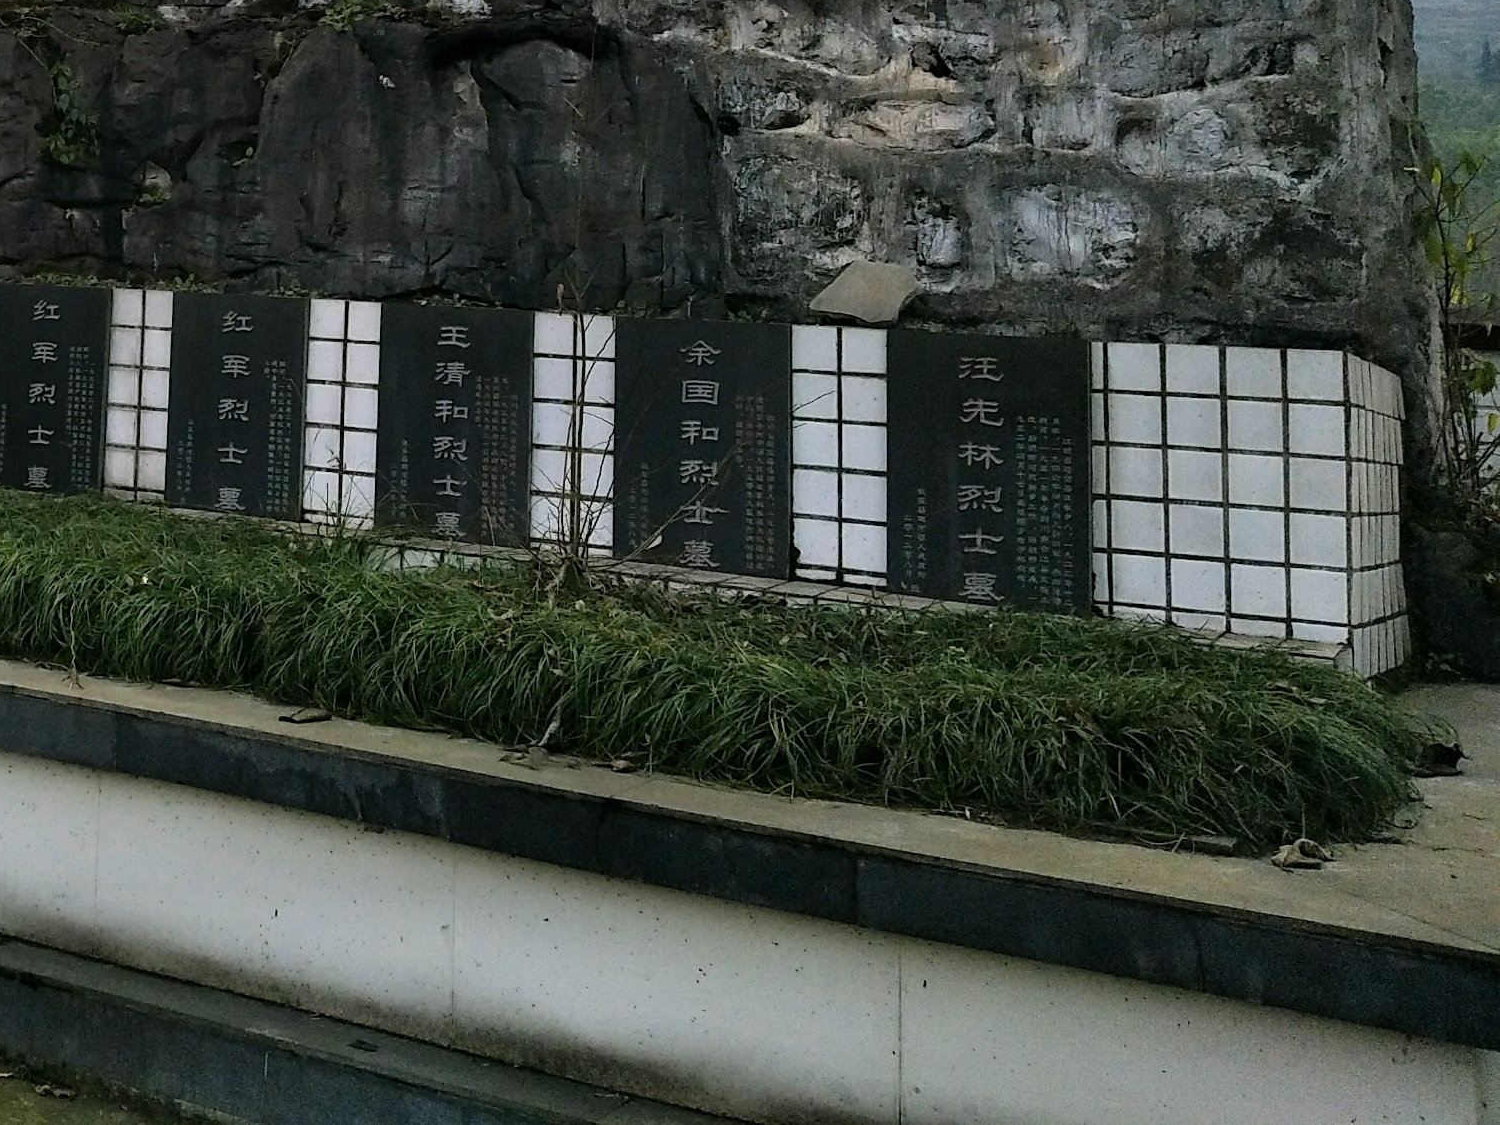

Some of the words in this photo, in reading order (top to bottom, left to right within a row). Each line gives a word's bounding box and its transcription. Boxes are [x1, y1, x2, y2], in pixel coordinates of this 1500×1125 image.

[23, 298, 61, 490] 红军烈士墓
[213, 310, 254, 511] 红军烈士墓
[432, 325, 472, 537] 王清和烈士墓
[679, 339, 725, 568] 余国和烈士墓
[957, 356, 1005, 601] 汪先林烈士墓
